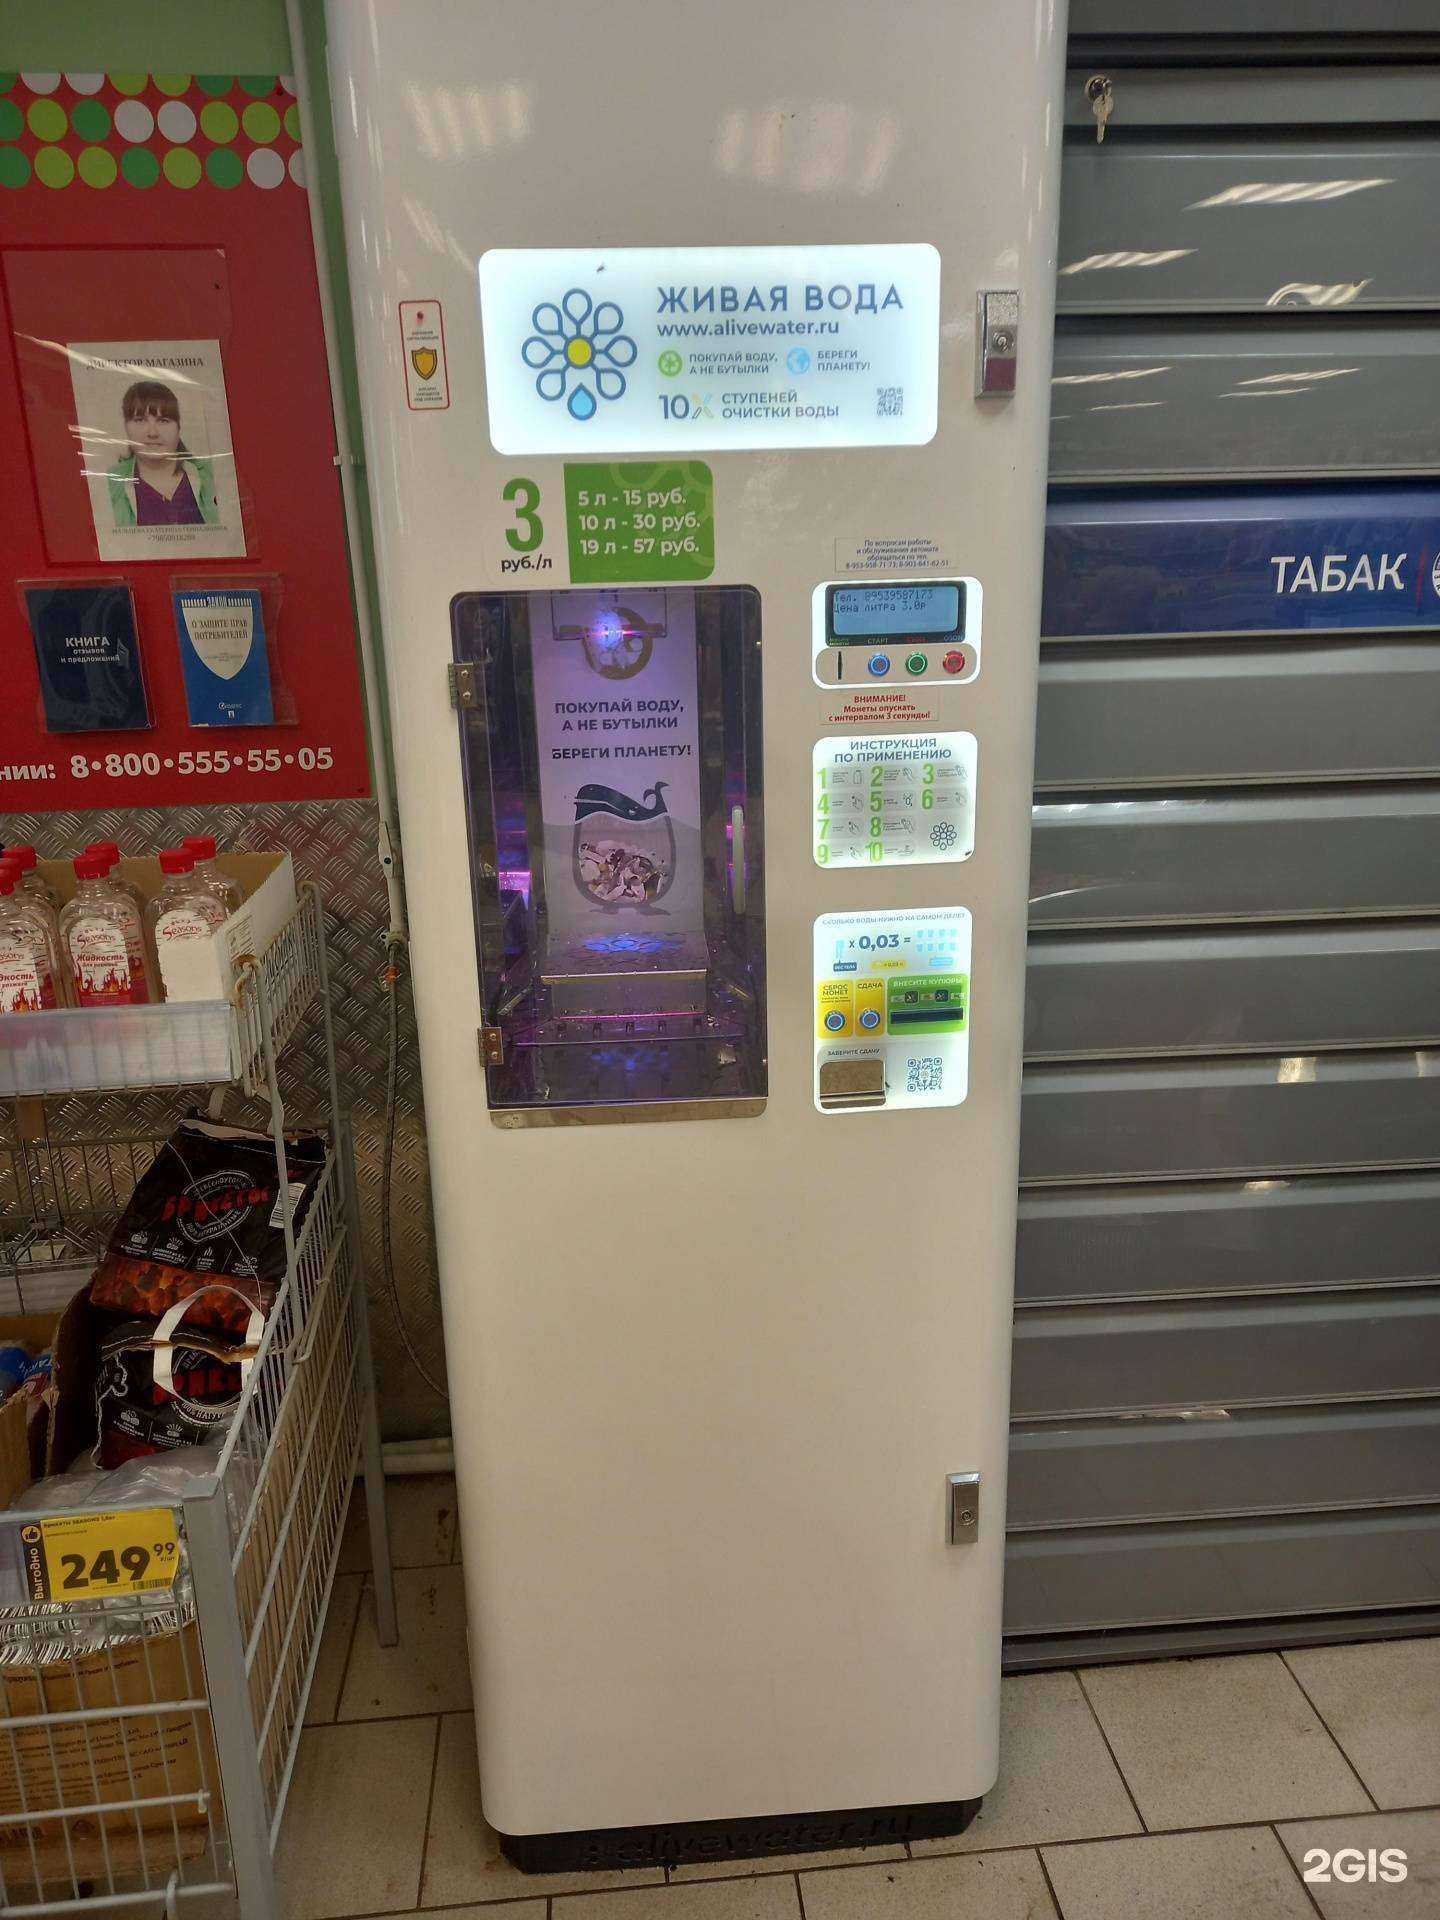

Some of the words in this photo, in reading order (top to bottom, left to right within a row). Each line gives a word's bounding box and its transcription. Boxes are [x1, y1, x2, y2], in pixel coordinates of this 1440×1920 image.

[657, 285, 788, 313] ЖИВАЯ
[805, 283, 904, 314] ВОДА
[657, 317, 840, 337] www.alivewater.ru
[689, 351, 743, 363] ПОКУПАЙ
[745, 350, 778, 363] ВОДУ,
[817, 350, 858, 359] БЕРЕГИ
[145, 357, 204, 369] МАГАЗИНА
[689, 365, 698, 375] А
[699, 365, 715, 375] НЕ
[717, 364, 770, 375] БУТЫЛКИ
[817, 361, 871, 372] ПЛАНЕТУ!
[722, 389, 798, 404] СТУПЕНЕЙ
[722, 406, 791, 420] ОЧИСТКИ
[795, 404, 840, 419] ВОДЫ
[578, 491, 590, 507] 5
[594, 493, 606, 507] л
[622, 489, 643, 506] 15
[646, 487, 688, 510] руб.
[502, 478, 544, 552] 3
[579, 514, 600, 531] 10
[604, 516, 616, 531] л
[633, 514, 657, 530] 30
[661, 512, 701, 534] руб.
[579, 539, 600, 556] 19
[604, 541, 617, 556] л
[633, 539, 656, 555] 57
[659, 537, 700, 559] руб.
[500, 554, 553, 572] руб./л
[1270, 553, 1408, 594] ТАБАК
[864, 602, 896, 612] литра
[200, 619, 228, 629] ЗАЩИТЕ
[65, 635, 111, 648] КНИГА
[73, 647, 105, 655] отзывов
[554, 698, 633, 714] ПОКУПАЙ
[636, 698, 684, 714] ВОДУ,
[854, 695, 906, 704] ВНИМАНИЕ!
[834, 713, 886, 722] интервалом
[893, 711, 931, 721] секунды!
[844, 705, 877, 713] Монеты
[878, 704, 916, 714] опускать
[562, 720, 573, 731] А
[577, 719, 598, 731] НЕ
[601, 717, 678, 731] БУТЫЛКИ
[552, 747, 610, 760] БЕРЕГИ
[614, 744, 691, 759] ПЛАНЕТУ!
[850, 738, 937, 751] ИНСТРУКЦИЯ
[834, 753, 854, 763] ПО
[857, 749, 952, 763] ПРИМЕНЕНИЮ
[816, 768, 827, 789] 1
[870, 765, 883, 787] 2
[922, 763, 935, 785] 3
[817, 794, 830, 815] 4
[870, 791, 883, 813] 5
[921, 789, 934, 810] 6
[817, 819, 831, 840] 7
[870, 816, 882, 837] 8
[817, 844, 830, 864] 9
[865, 842, 884, 862] 10
[858, 934, 900, 951] 0,03
[75, 953, 125, 963] Жидкость
[927, 977, 962, 986] КУПЮРЫ
[30, 1547, 44, 1600] Выгодно
[61, 1545, 151, 1590] 249
[153, 1542, 176, 1557] 99
